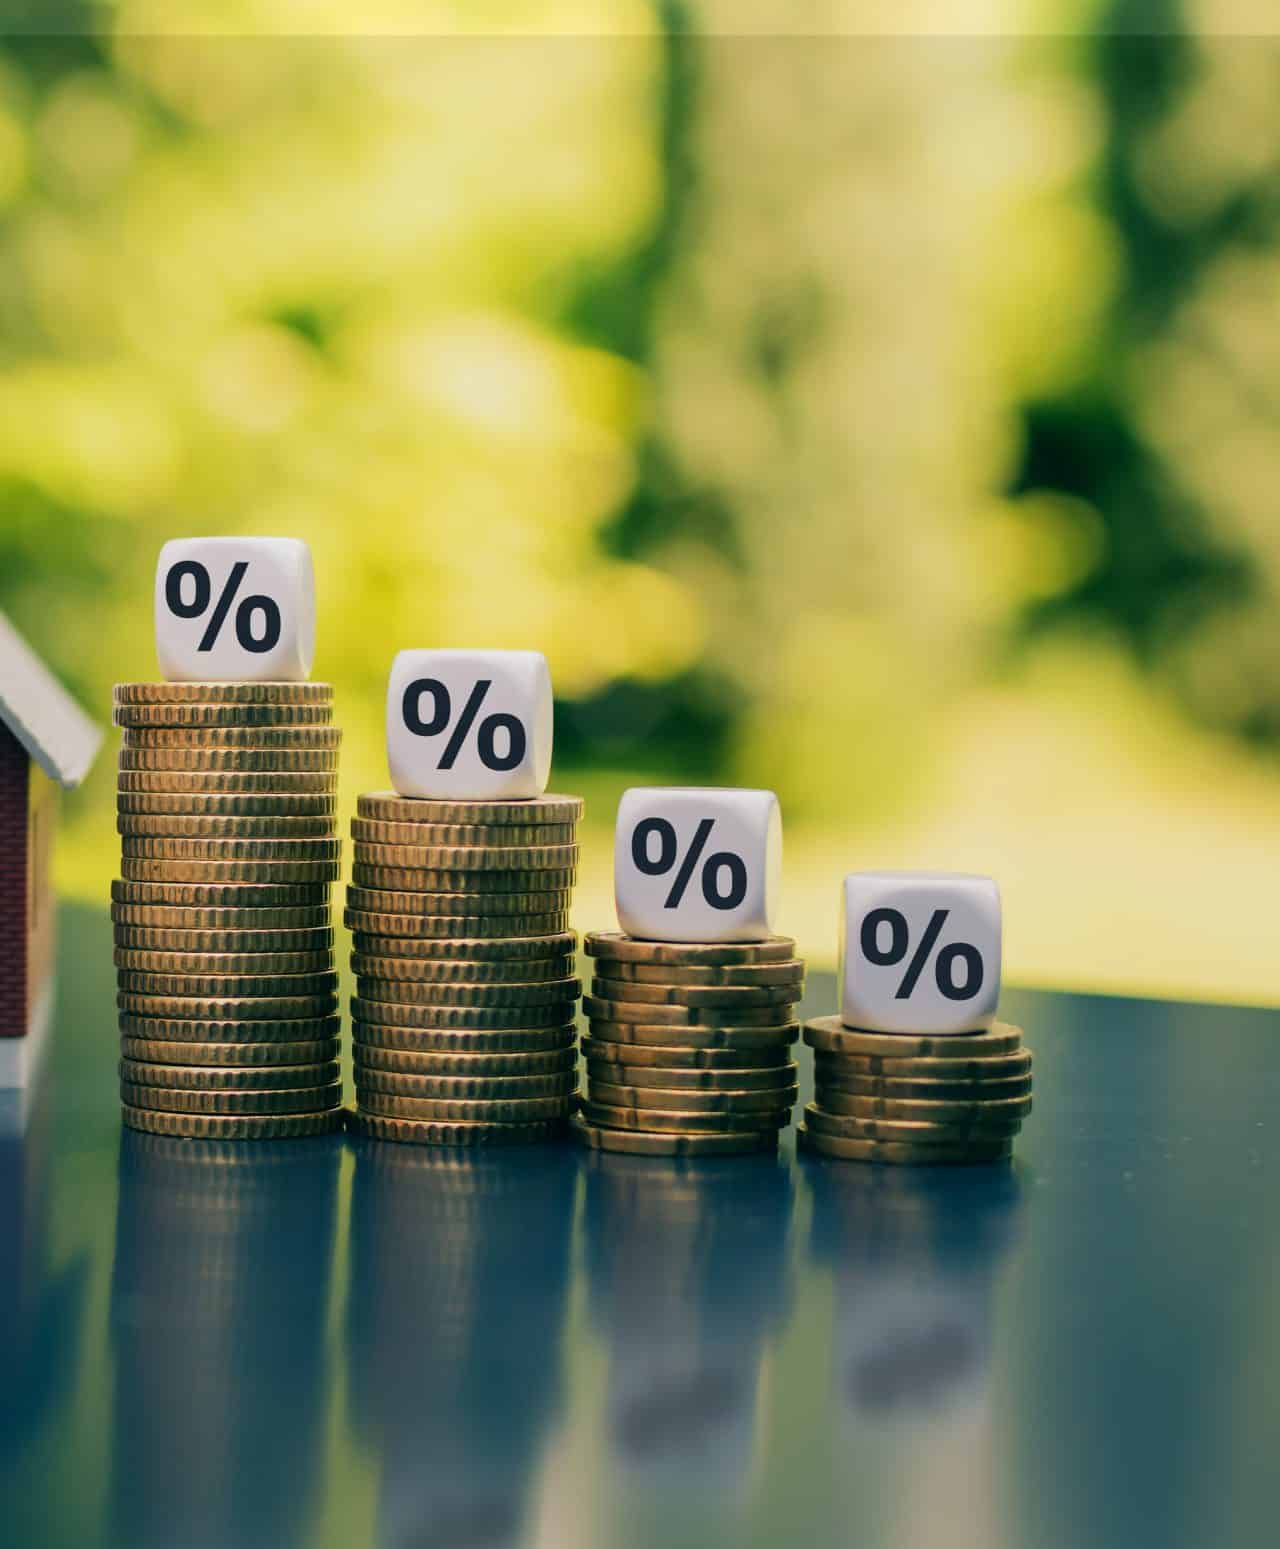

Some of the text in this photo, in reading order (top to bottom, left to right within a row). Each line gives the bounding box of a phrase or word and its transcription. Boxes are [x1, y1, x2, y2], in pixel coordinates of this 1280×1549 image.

[165, 560, 282, 654] %
[402, 678, 527, 772] %
[631, 817, 748, 911] %
[860, 907, 984, 1001] %
